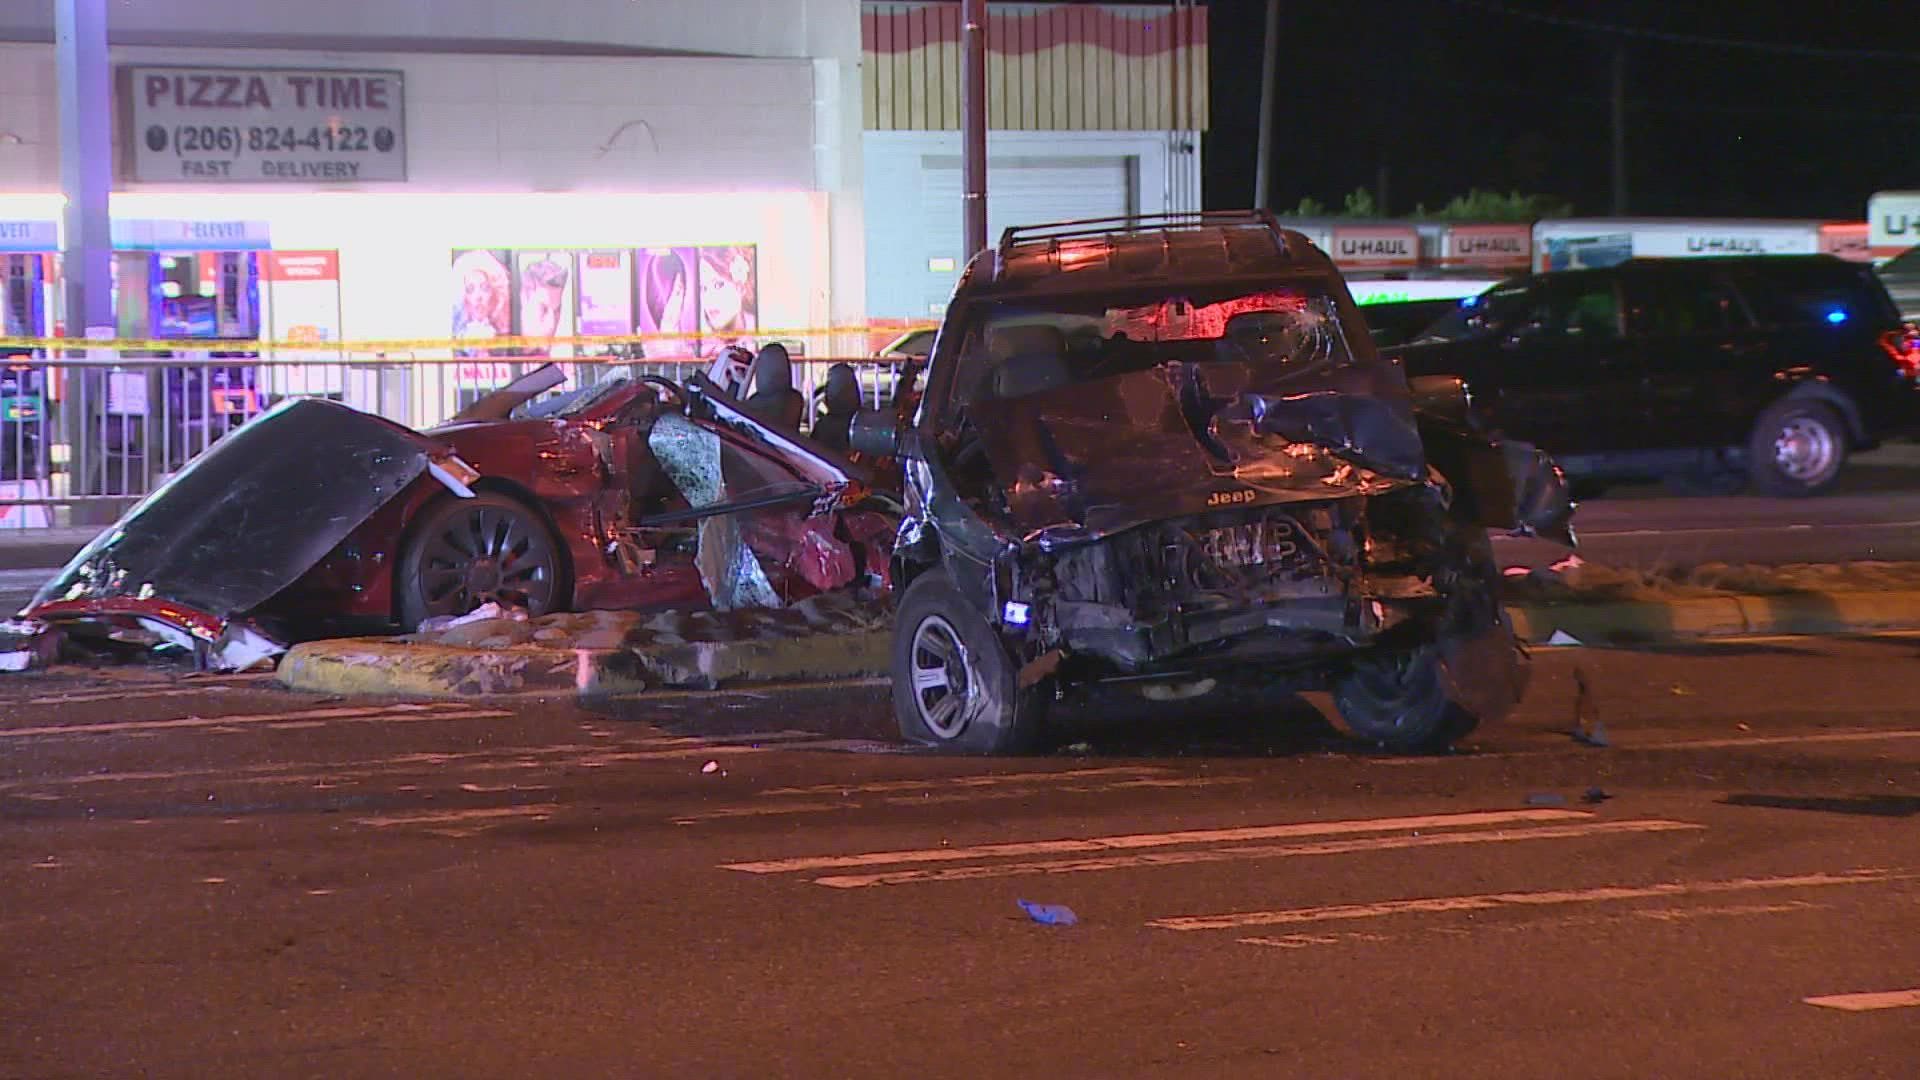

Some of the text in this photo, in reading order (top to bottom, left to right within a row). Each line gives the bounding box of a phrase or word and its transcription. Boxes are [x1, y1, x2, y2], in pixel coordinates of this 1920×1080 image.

[145, 75, 388, 109] PIZZA TIME
[174, 126, 368, 156] (206) 824-4122
[181, 159, 360, 178] FAST DELIVERY
[1342, 239, 1408, 255] U-HAUL
[1458, 236, 1521, 253] U-HAUL
[1686, 237, 1766, 253] U-HAUL
[1207, 489, 1256, 505] Jeep
